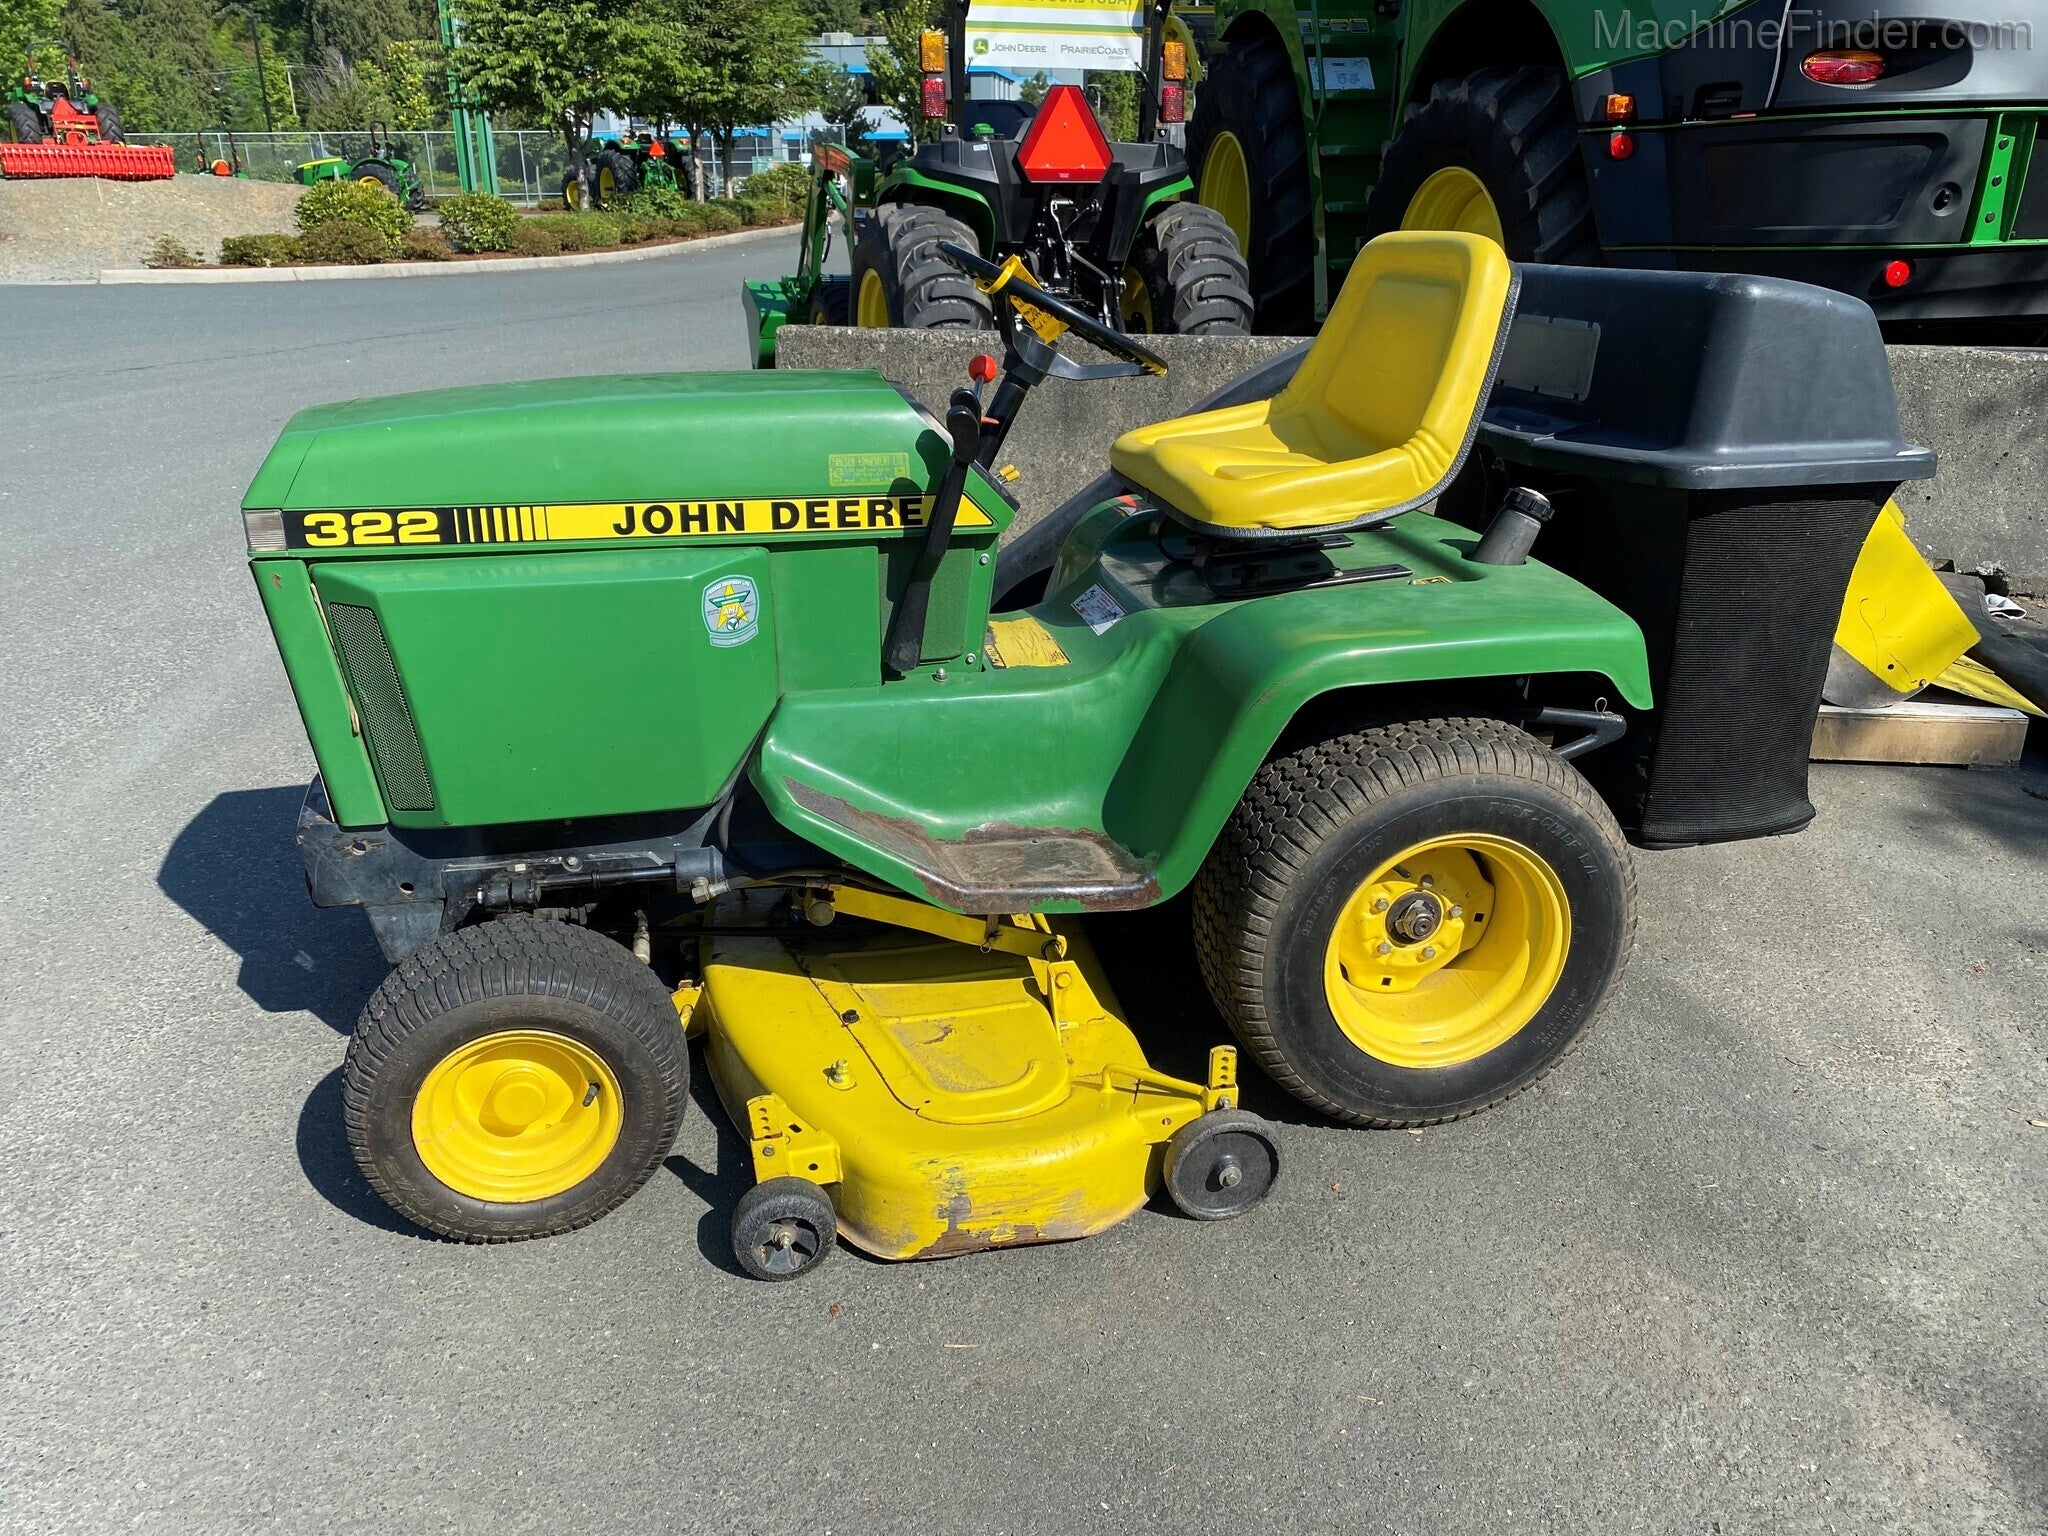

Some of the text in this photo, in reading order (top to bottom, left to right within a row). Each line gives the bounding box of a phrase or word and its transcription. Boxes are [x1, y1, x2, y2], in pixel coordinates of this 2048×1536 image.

[991, 43, 1047, 53] JOHN DEERE
[1060, 44, 1130, 56] PRAIRIECOAST
[303, 510, 441, 547] 322
[612, 497, 925, 536] JOHN DEERE
